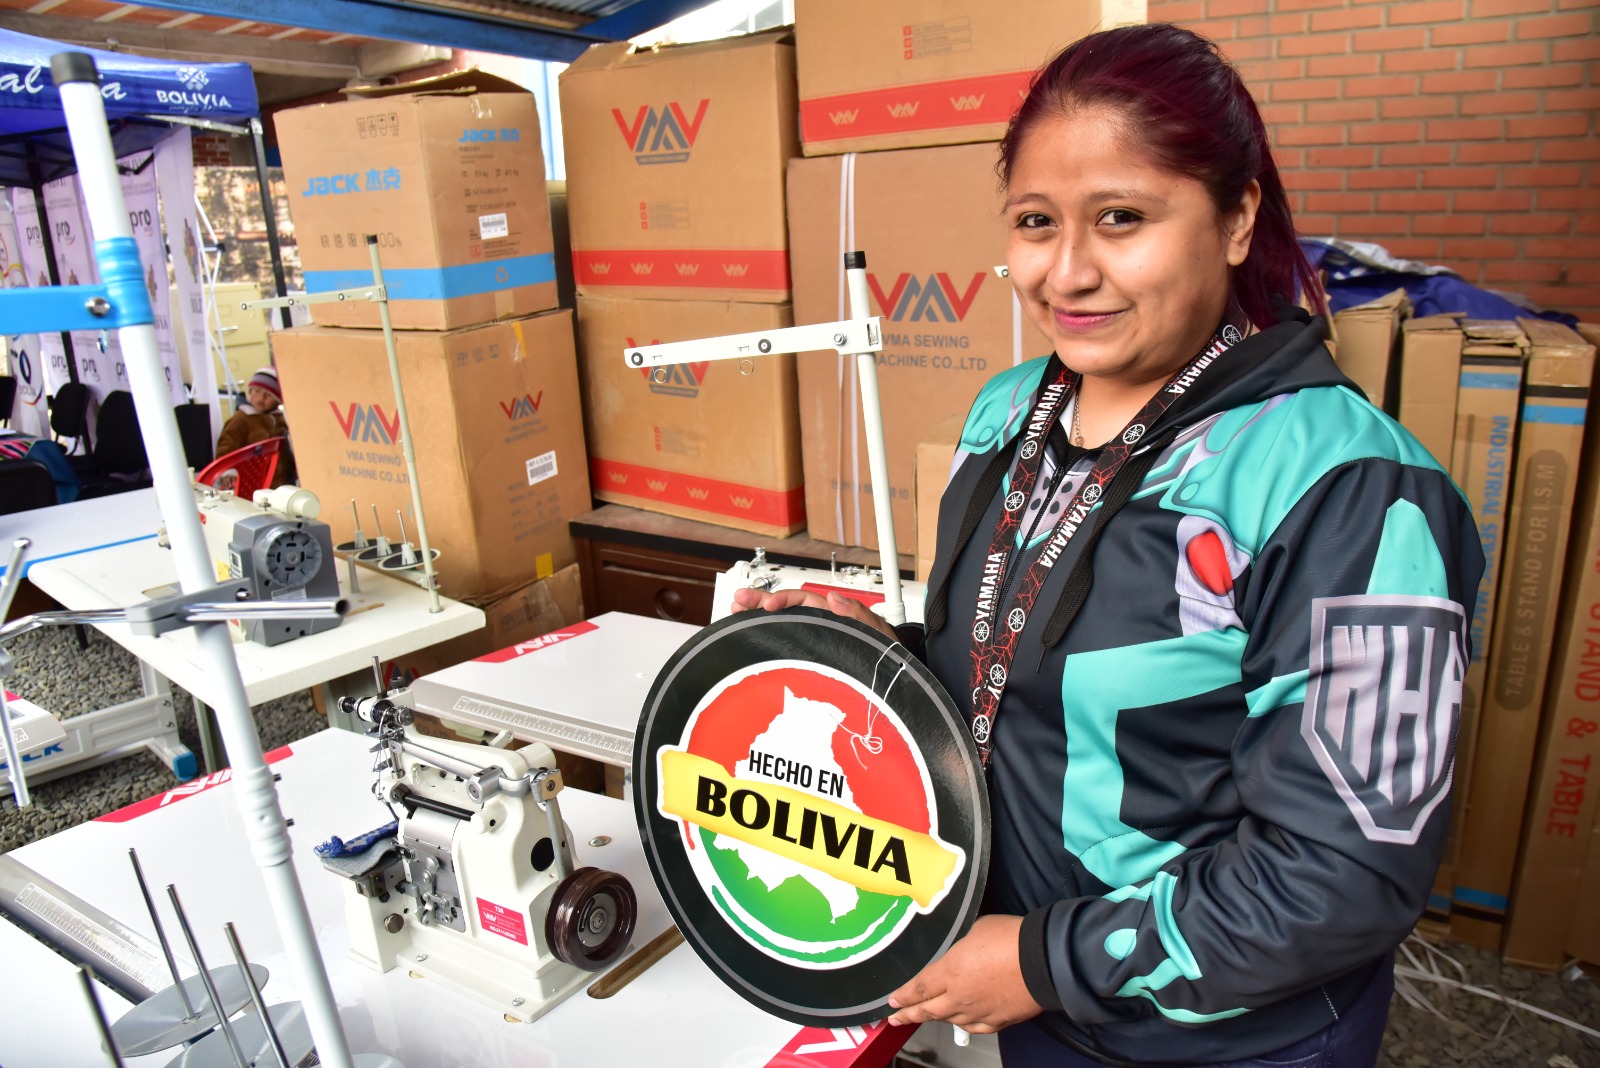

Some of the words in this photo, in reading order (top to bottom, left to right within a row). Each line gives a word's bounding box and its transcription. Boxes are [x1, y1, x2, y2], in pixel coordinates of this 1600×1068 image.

[156, 89, 232, 109] BOLIVIA
[302, 173, 361, 197] JACK
[365, 166, 401, 192] 杰克
[26, 225, 40, 246] pro
[56, 221, 71, 242] pro
[129, 209, 152, 234] pro
[882, 334, 910, 347] VMA
[914, 334, 970, 349] SEWING
[932, 356, 987, 371] CO.,LTD
[1168, 340, 1229, 394] YAMAHA
[1025, 384, 1066, 440] YAMAHA
[339, 465, 377, 480] MACHINE
[380, 471, 411, 485] CO.,LT
[346, 450, 365, 461] VMA
[366, 452, 402, 467] SEWING
[1482, 416, 1509, 517] INDUSTRIAL
[1040, 504, 1091, 568] YAMAHA
[1526, 516, 1549, 554] FOR
[976, 552, 1003, 621] YAMAHA
[1517, 560, 1542, 620] STAND
[1519, 626, 1533, 638] &
[1505, 642, 1531, 697] TABLE
[1566, 716, 1598, 738] &
[749, 749, 813, 788] HECHO
[818, 771, 845, 799] EN
[1545, 754, 1592, 839] TABLE
[695, 775, 913, 886] BOLIVIA
